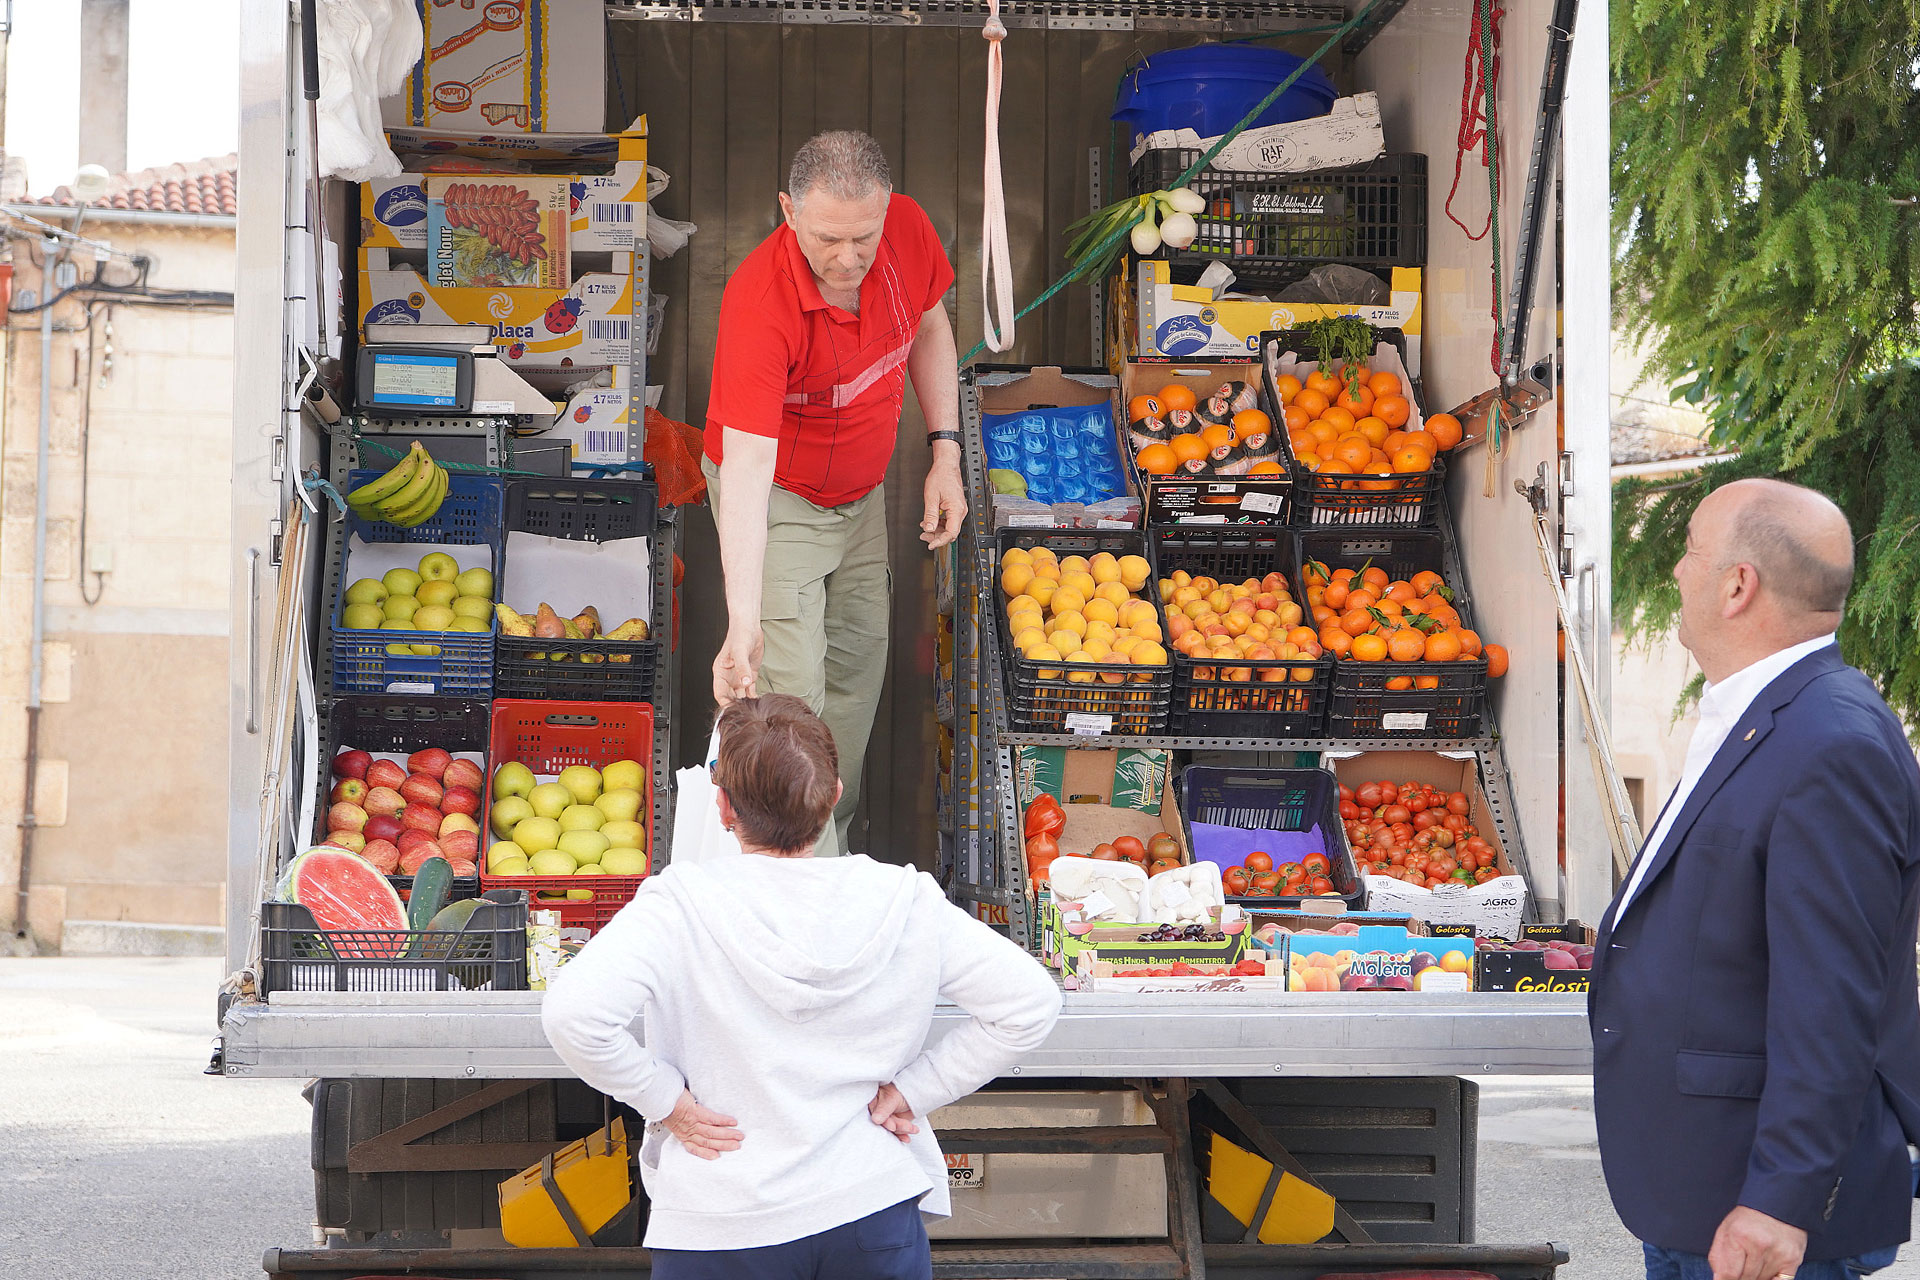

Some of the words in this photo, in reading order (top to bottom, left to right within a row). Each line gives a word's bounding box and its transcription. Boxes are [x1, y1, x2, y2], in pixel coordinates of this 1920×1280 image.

[1261, 144, 1285, 165] RAF
[593, 177, 607, 188] 17
[437, 226, 454, 260] Nour
[587, 284, 601, 294] 17
[1371, 310, 1385, 319] 17
[593, 394, 607, 404] 17
[1481, 898, 1518, 907] AGRO
[1435, 925, 1471, 934] Golosito
[1527, 926, 1562, 934] Golosito
[1351, 952, 1379, 962] Frutas
[1350, 955, 1412, 977] Molera
